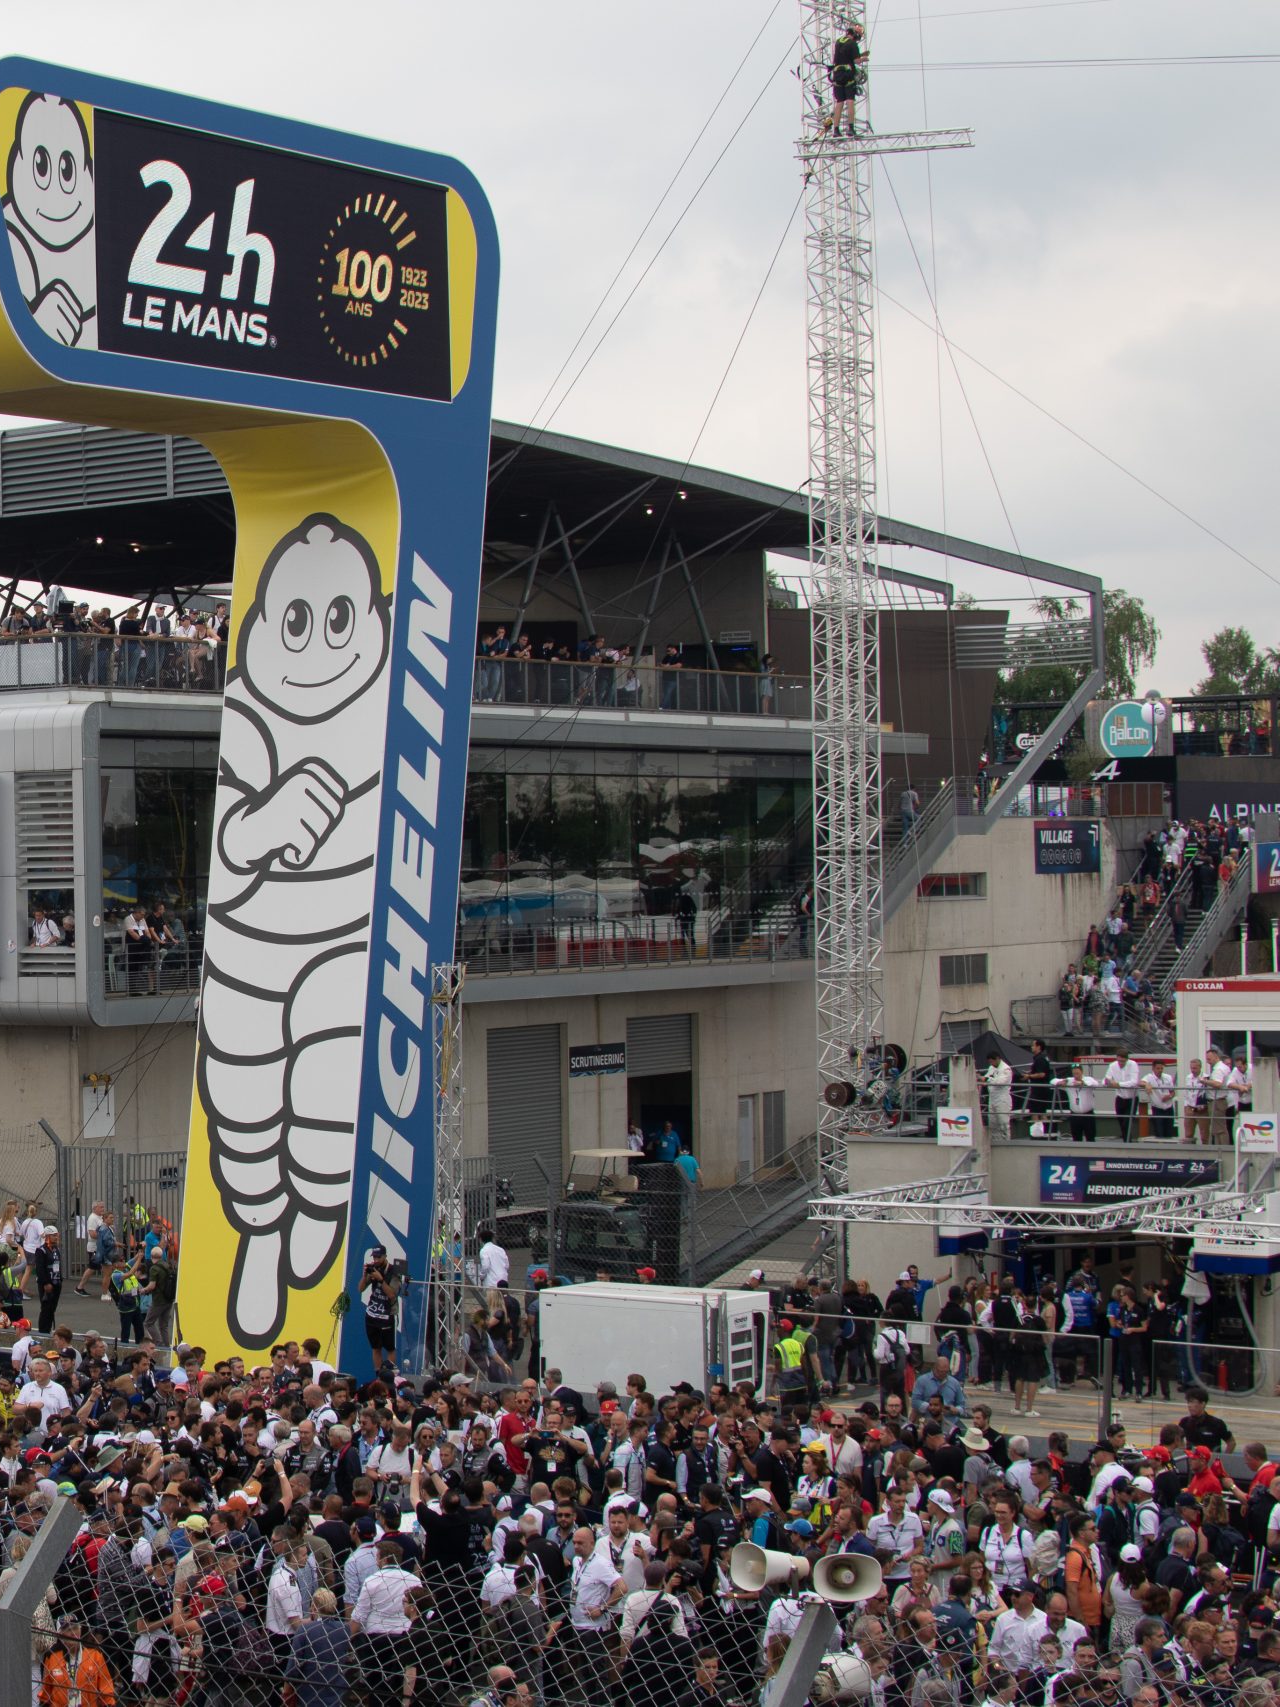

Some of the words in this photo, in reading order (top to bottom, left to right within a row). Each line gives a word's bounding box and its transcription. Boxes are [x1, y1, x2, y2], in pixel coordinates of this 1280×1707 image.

[127, 159, 276, 306] 24h
[331, 247, 393, 303] 100
[401, 265, 428, 288] 1923
[344, 300, 374, 318] ANS
[399, 288, 430, 311] 2023
[122, 292, 166, 331] LE
[1039, 830, 1073, 844] VILLAGE
[360, 550, 454, 1334] MICHELIN
[1192, 982, 1225, 990] LOXAM
[570, 1053, 625, 1069] SCRUTINEERING
[1048, 1165, 1077, 1185] 24
[1105, 1162, 1144, 1170] INNOVATIVE
[1086, 1185, 1141, 1196] HENDRICK
